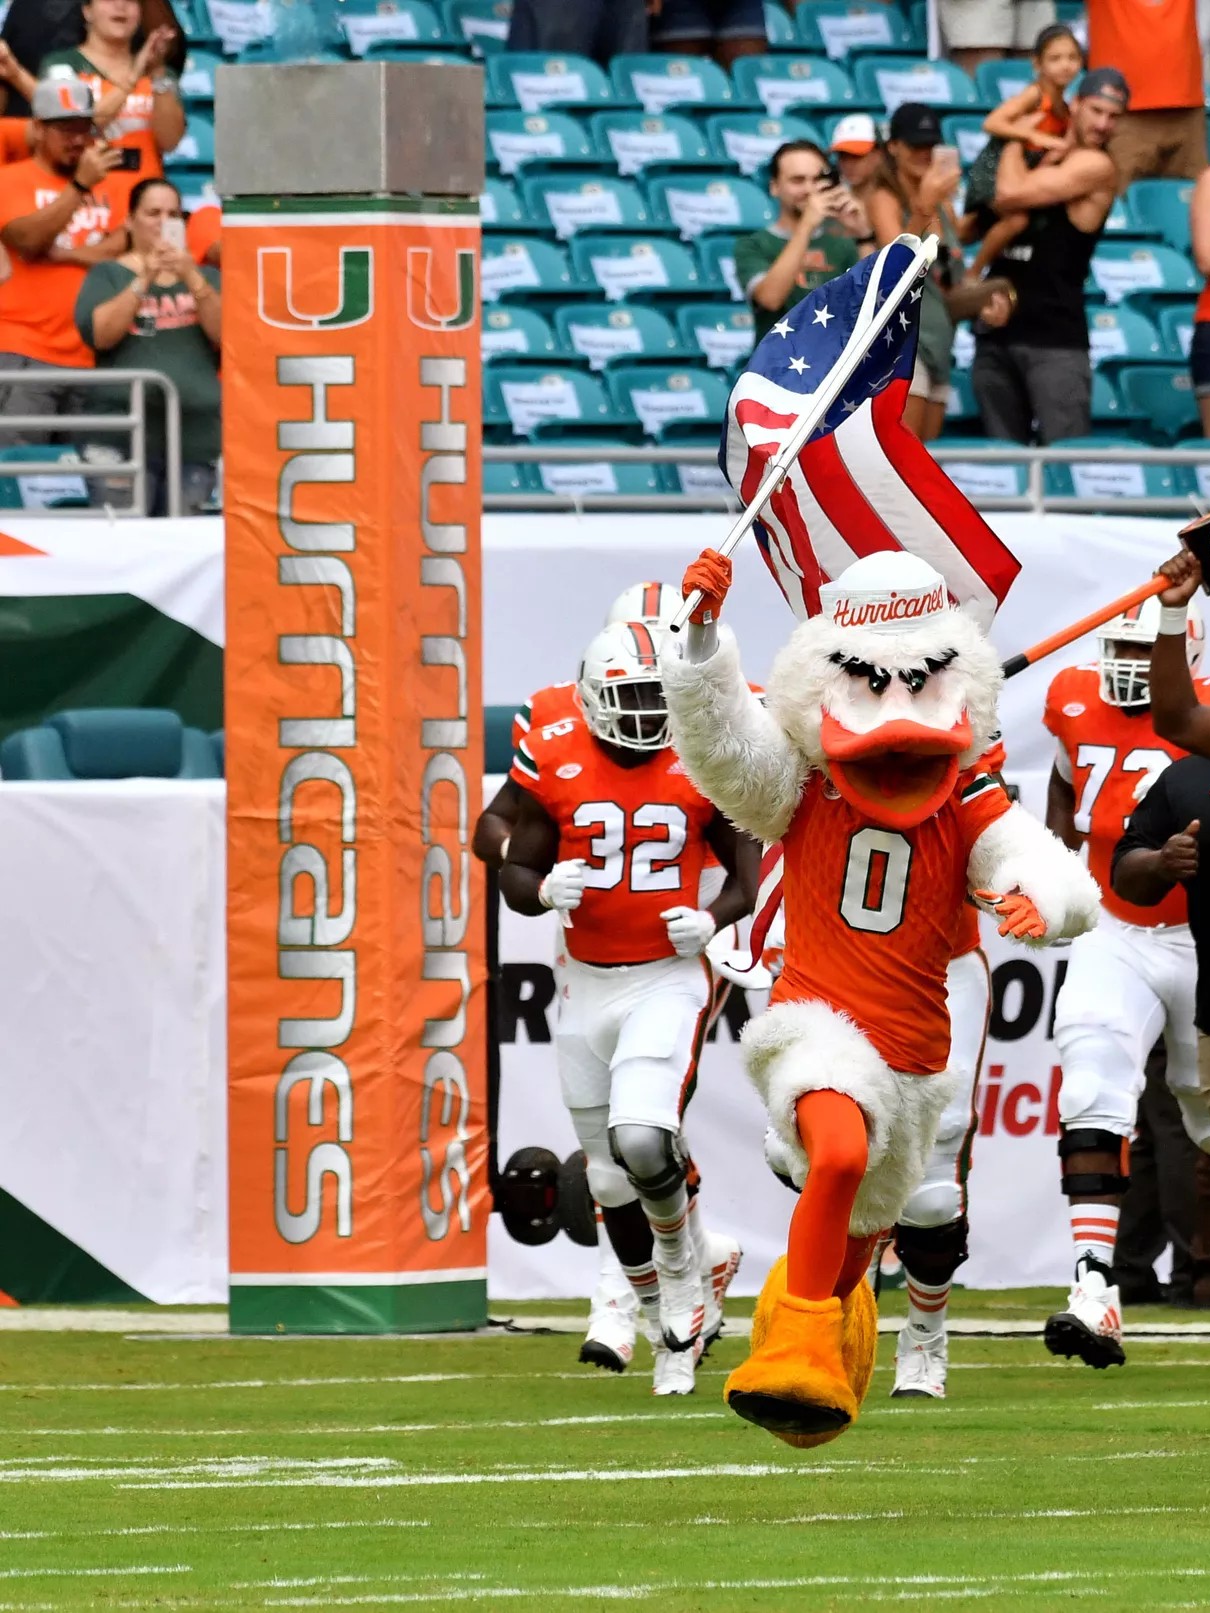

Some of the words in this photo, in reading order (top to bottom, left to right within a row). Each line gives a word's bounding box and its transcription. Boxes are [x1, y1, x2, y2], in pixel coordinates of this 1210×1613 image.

[257, 246, 375, 331] U
[406, 246, 477, 332] U
[833, 584, 944, 628] Hurricanes
[273, 354, 357, 1244] Hurricanes
[418, 355, 472, 1241] Hurricanes
[572, 800, 688, 892] 32
[838, 826, 912, 936] 0
